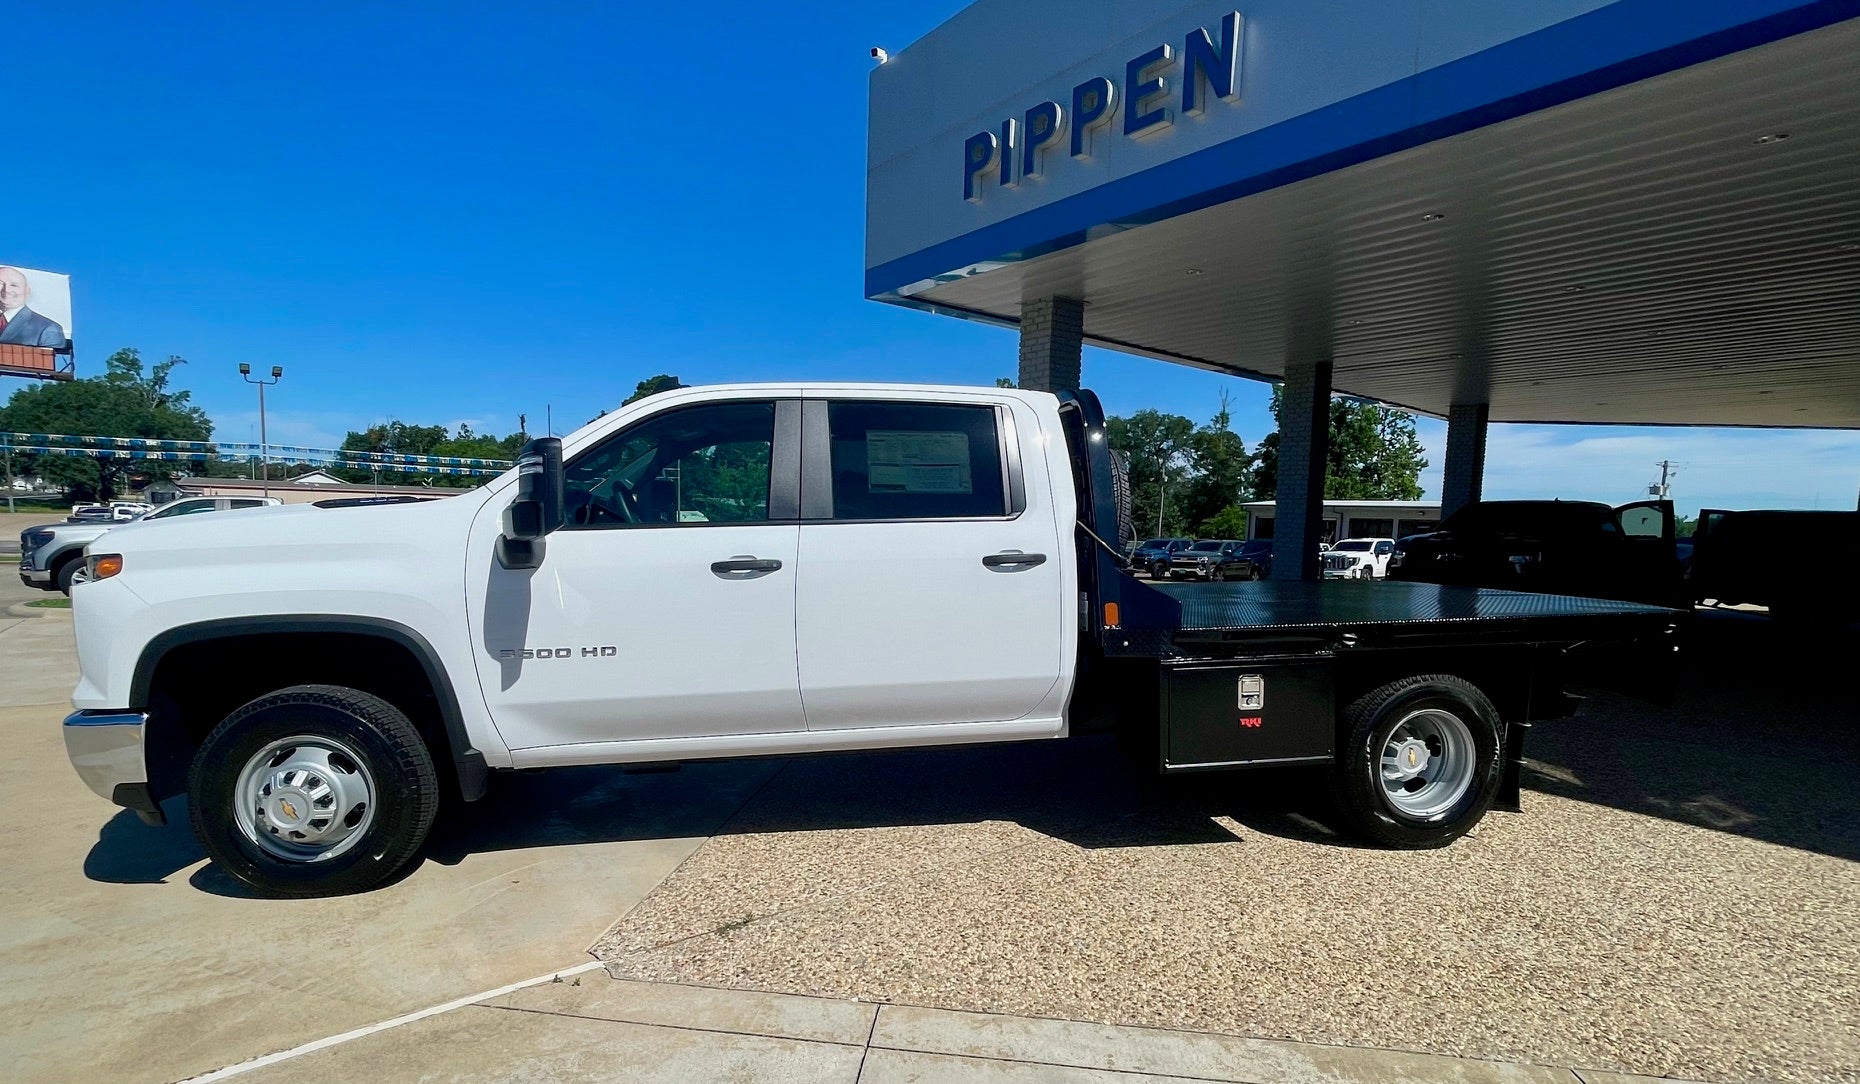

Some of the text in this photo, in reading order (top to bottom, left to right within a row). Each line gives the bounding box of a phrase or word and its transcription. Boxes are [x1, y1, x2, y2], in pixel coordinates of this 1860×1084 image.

[963, 10, 1243, 201] PIPPEN
[500, 646, 617, 659] 3500 HD
